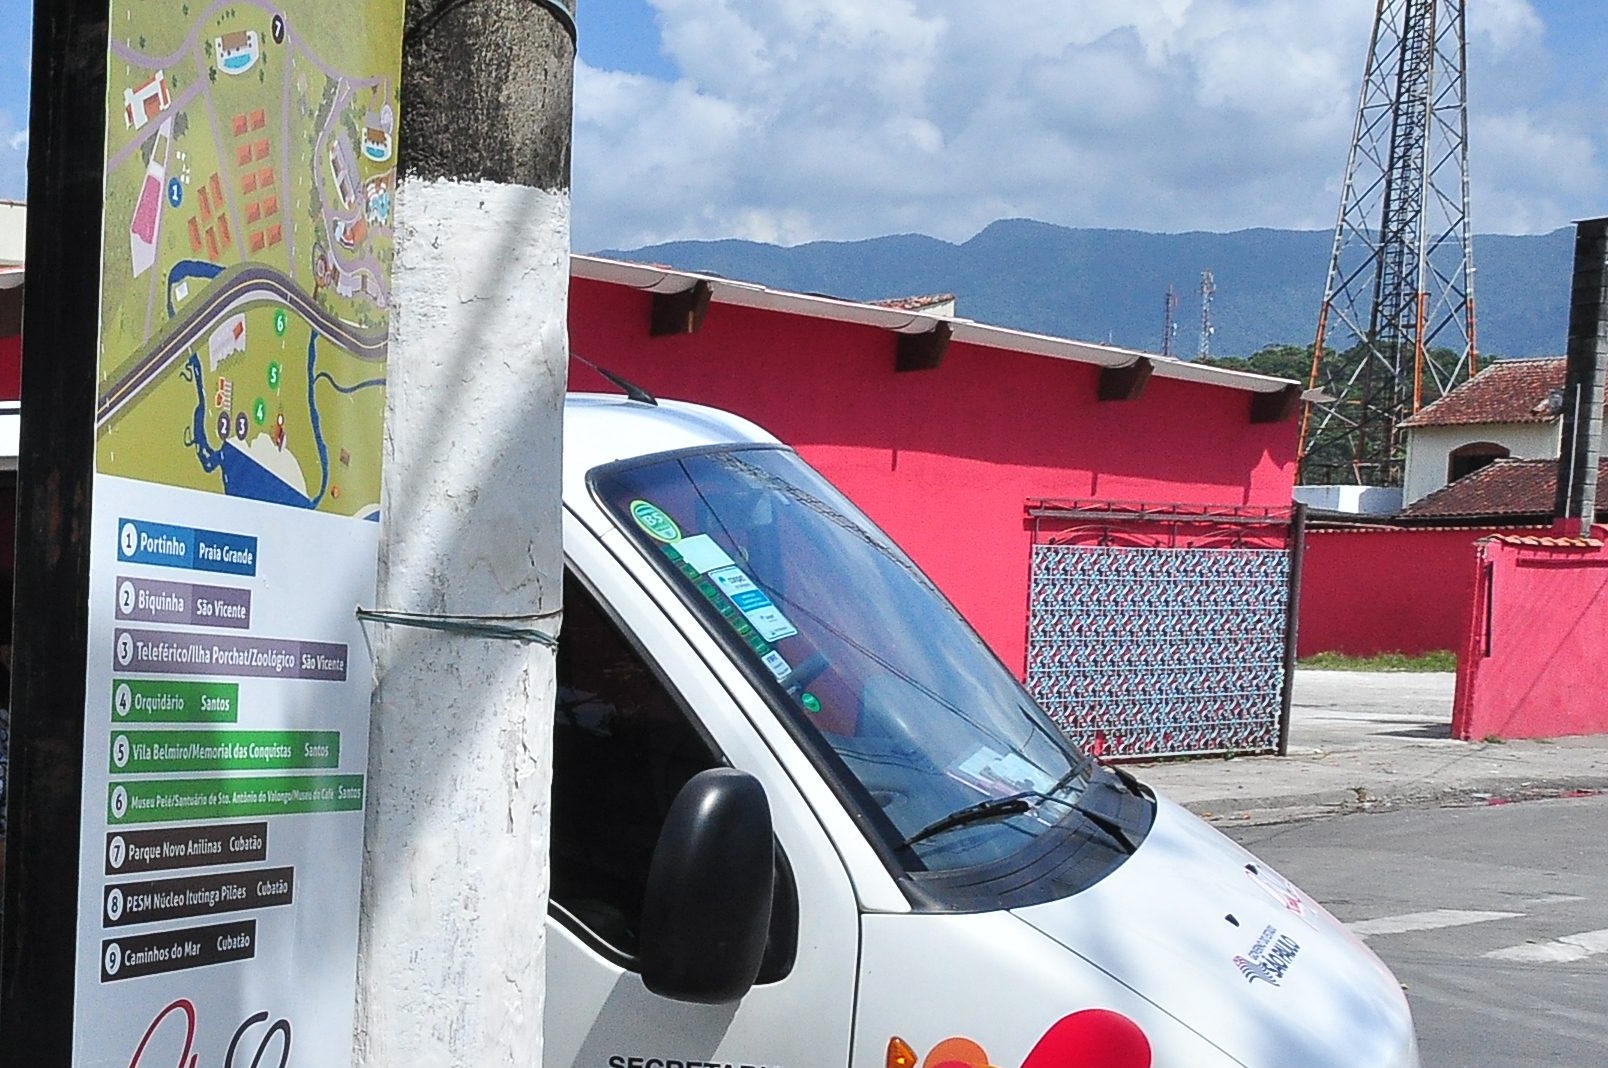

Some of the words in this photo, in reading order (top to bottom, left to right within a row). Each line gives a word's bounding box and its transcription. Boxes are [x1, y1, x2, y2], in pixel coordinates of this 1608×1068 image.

[140, 532, 186, 556] Portinho
[199, 542, 222, 561] Praia
[223, 546, 253, 565] Grande
[138, 590, 184, 615] Biquinha
[196, 599, 212, 615] São
[214, 601, 246, 619] Vicente
[136, 642, 210, 664] Teleférico/Ilha
[212, 649, 295, 671] Porchat/Zoológico
[301, 655, 315, 670] São
[317, 657, 344, 671] Vicente
[135, 694, 184, 714] Orquidário
[201, 694, 230, 711] Santos
[133, 744, 151, 760] Vila
[153, 743, 232, 760] Belmiro/Memorial
[233, 743, 248, 758] das
[249, 743, 292, 762] Conquistas
[304, 743, 329, 758] Santos
[131, 795, 155, 809] Museu
[156, 793, 207, 808] Pelé/Santuário
[209, 792, 217, 805] de
[258, 790, 267, 802] do
[338, 785, 362, 799] Santos
[128, 843, 161, 863] Parque
[163, 841, 185, 858] Novo
[187, 838, 222, 857] Anilinas
[229, 835, 262, 852] Cubatão
[126, 894, 152, 912] PESM
[153, 890, 184, 909] Núcleo
[185, 887, 220, 908] Itutinga
[221, 885, 247, 902] Pilões
[256, 879, 288, 897] Cubatão
[124, 945, 169, 966] Caminhos
[171, 942, 182, 958] do
[184, 941, 201, 956] Mar
[217, 933, 250, 951] Cubatão
